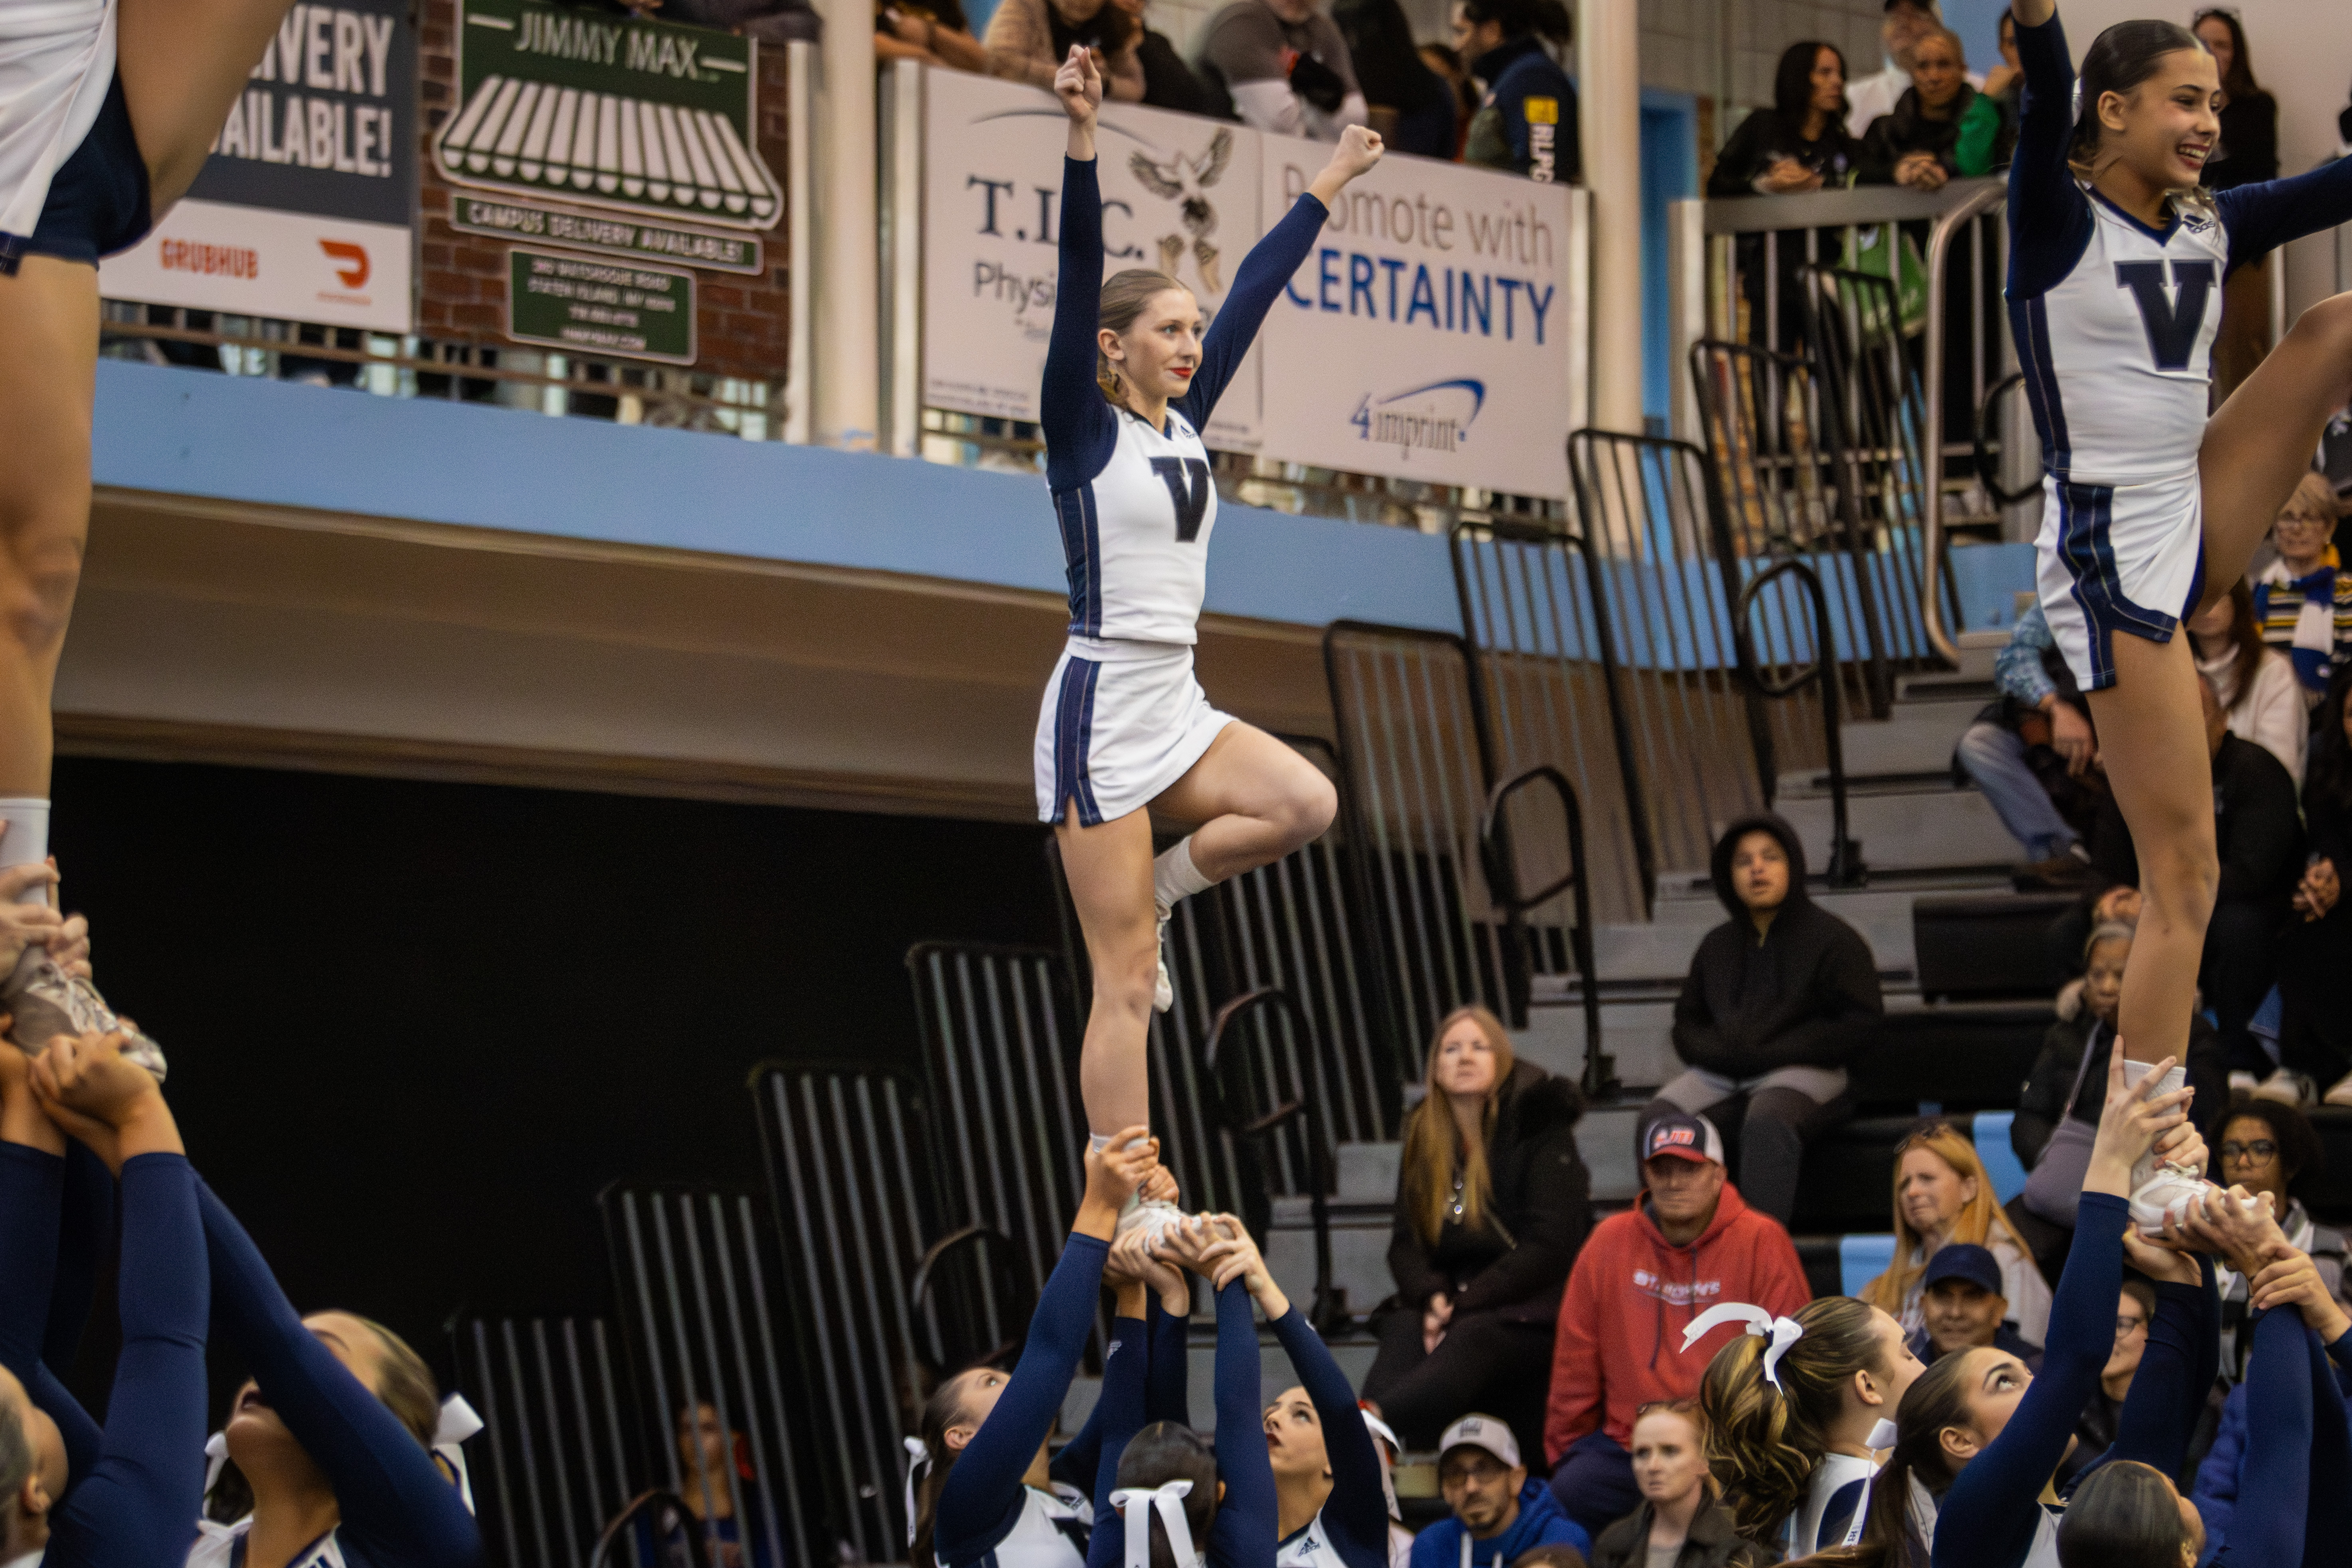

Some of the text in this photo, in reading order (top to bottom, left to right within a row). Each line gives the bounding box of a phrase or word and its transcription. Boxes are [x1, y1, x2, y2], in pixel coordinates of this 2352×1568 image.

[515, 11, 699, 79] JIMMY MAX
[468, 200, 745, 264] CAMPUS DELIVERY AVAILABLE!
[1282, 163, 1553, 267] Pomote with
[161, 238, 258, 280] GRUBHUB
[2113, 259, 2217, 372] V
[1147, 455, 1212, 543] V
